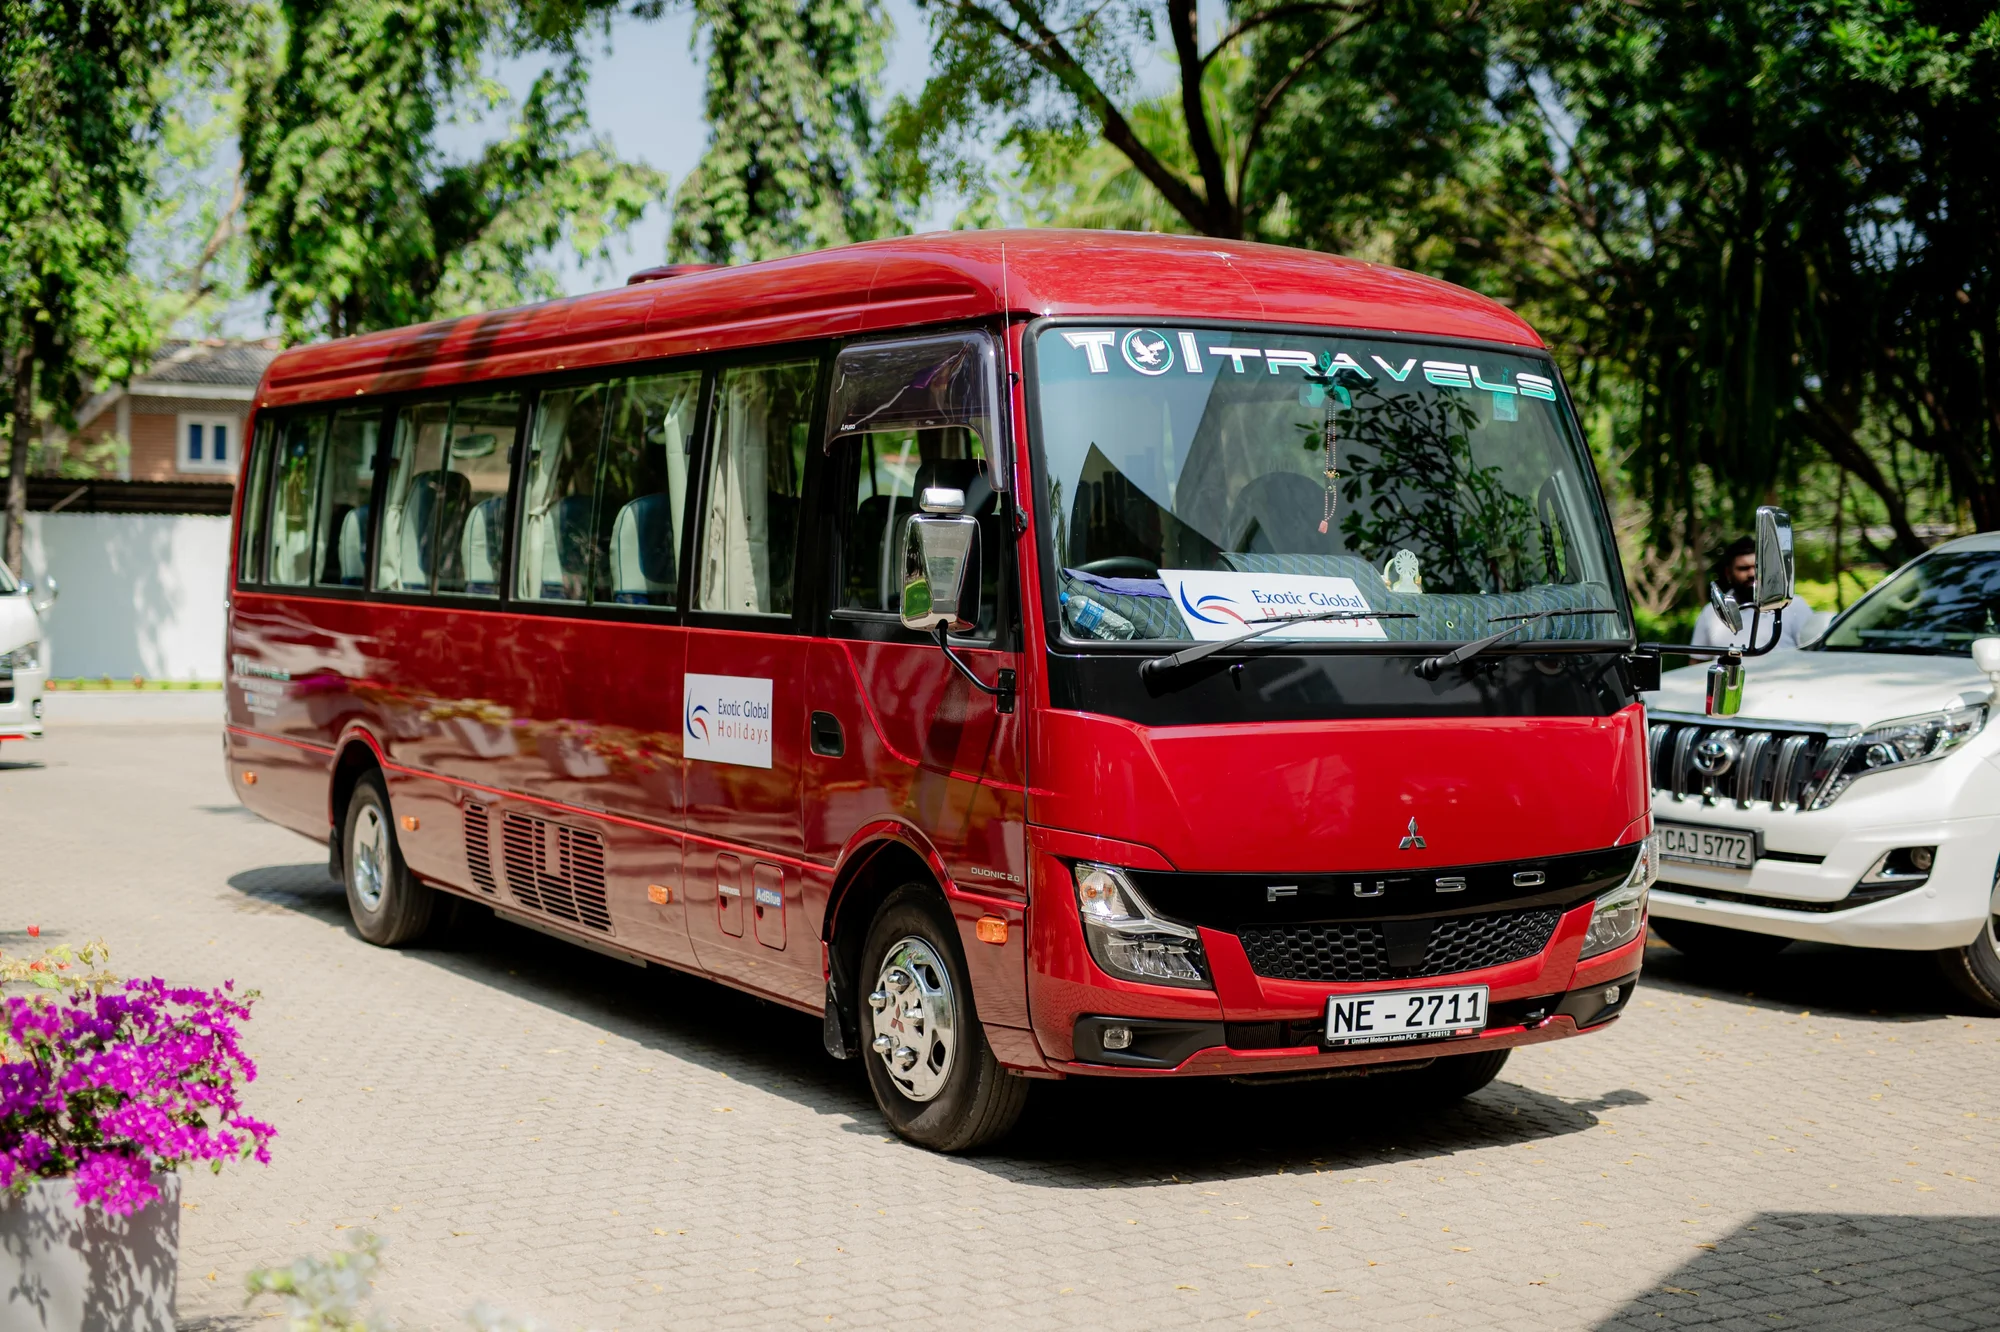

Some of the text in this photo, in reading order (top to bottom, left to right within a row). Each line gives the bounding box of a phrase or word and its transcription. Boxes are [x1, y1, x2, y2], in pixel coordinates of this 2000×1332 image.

[1209, 346, 1557, 402] TRAVELS
[1251, 589, 1364, 609] Exotic Global
[718, 698, 769, 720] Exotic Global
[717, 720, 768, 745] Holidays
[1665, 830, 1746, 860] CAJ 5772
[971, 867, 1020, 882] DUONIC 2.0
[1267, 870, 1546, 902] FUSO
[756, 888, 781, 906] AdBlue
[1334, 1000, 1374, 1034] NE
[1406, 992, 1481, 1028] 2711
